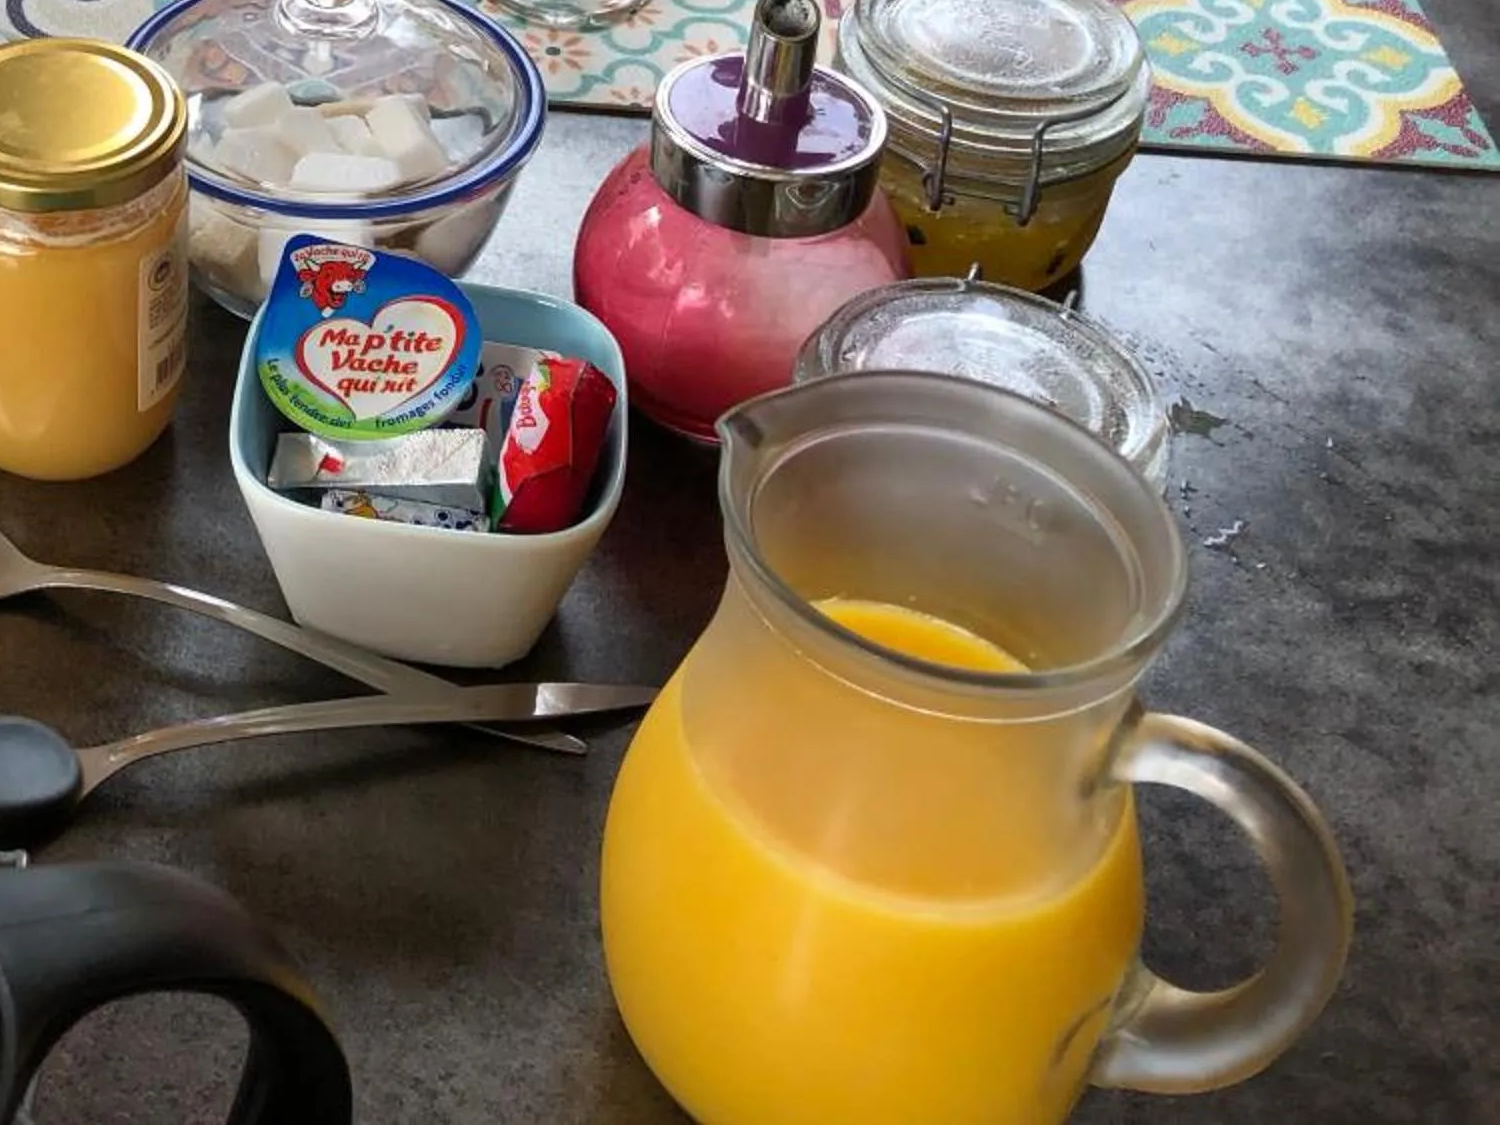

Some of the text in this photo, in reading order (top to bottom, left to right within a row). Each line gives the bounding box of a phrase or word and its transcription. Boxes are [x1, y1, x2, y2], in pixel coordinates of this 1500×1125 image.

[319, 324, 443, 355] Ma p'tite
[331, 348, 419, 374] Vache
[337, 376, 419, 398] qui rit
[375, 399, 436, 429] fromages
